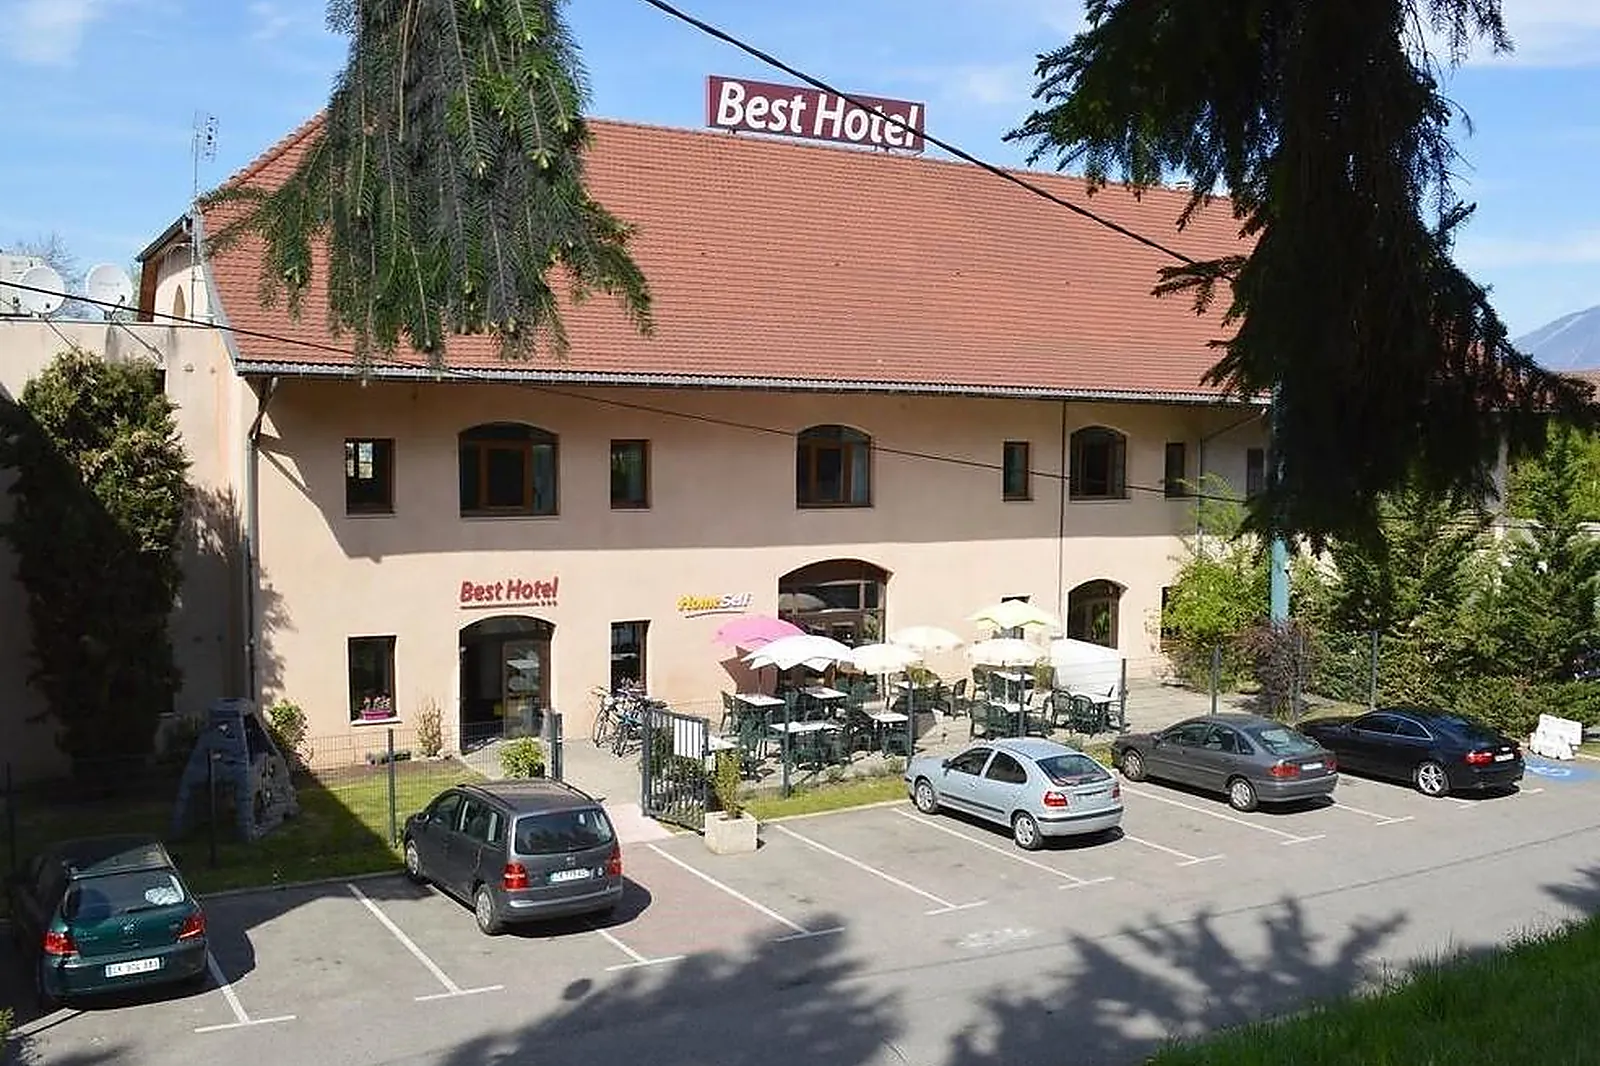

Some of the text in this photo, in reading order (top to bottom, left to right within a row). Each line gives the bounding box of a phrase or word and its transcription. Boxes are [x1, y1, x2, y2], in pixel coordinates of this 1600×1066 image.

[716, 80, 919, 147] Best Hotel
[460, 576, 559, 602] Best Hotel
